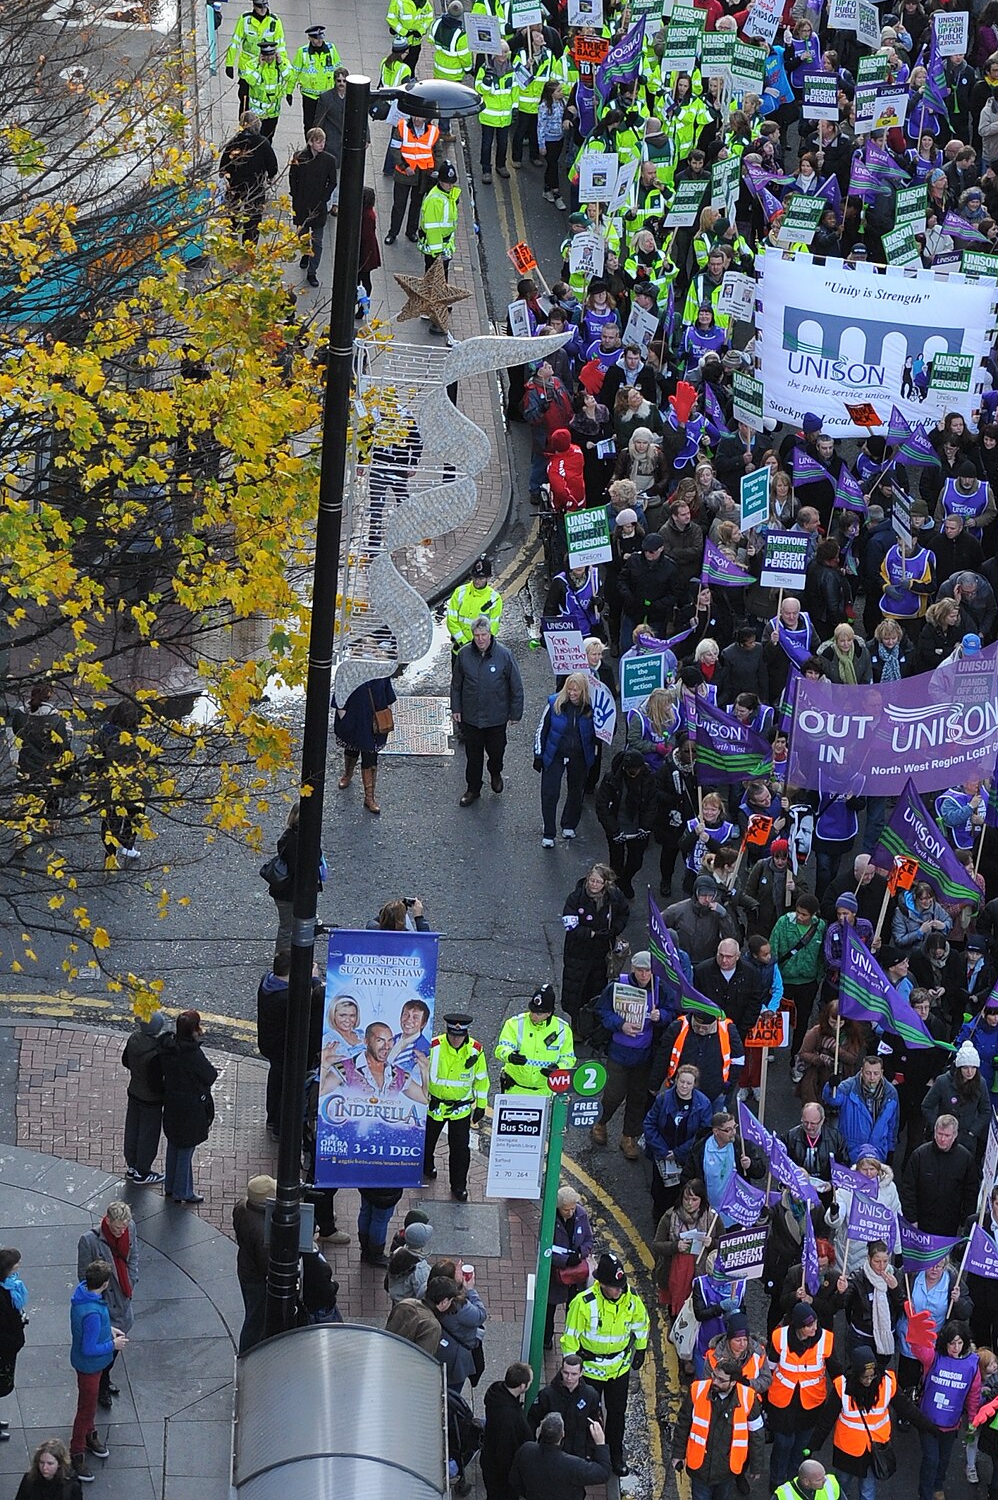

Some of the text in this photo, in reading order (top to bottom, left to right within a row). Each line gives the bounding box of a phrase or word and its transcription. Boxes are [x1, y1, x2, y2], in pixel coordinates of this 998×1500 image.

[938, 33, 963, 41] PUBLIC
[824, 281, 930, 305] "Unity is Strength"
[788, 352, 885, 386] UNISON
[787, 379, 891, 400] the public service union
[821, 413, 852, 426] Local
[566, 509, 606, 527] UNISON
[569, 536, 608, 551] PENSIONS
[767, 535, 808, 546] EVERYONE
[767, 544, 806, 552] DESERVES
[773, 551, 806, 561] DECENT
[765, 558, 804, 570] PENSION
[626, 660, 660, 670] Supporting
[629, 675, 656, 685] pensions
[798, 710, 874, 740] OUT
[891, 697, 998, 753] UNISON
[819, 744, 845, 765] IN
[871, 745, 990, 775] North West Region LGBT
[345, 955, 420, 967] LOUIE SPENCE
[340, 966, 424, 977] SUZANNE SHAW
[354, 977, 409, 987] TAM RYAN
[549, 1076, 570, 1086] WH
[583, 1068, 597, 1089] 2
[321, 1095, 423, 1128] CINDERELLA
[574, 1102, 598, 1110] FREE
[574, 1117, 594, 1125] BUS
[500, 1124, 538, 1134] Bus Stop
[353, 1143, 421, 1157] 3-31 DEC
[938, 1368, 963, 1381] UNISON
